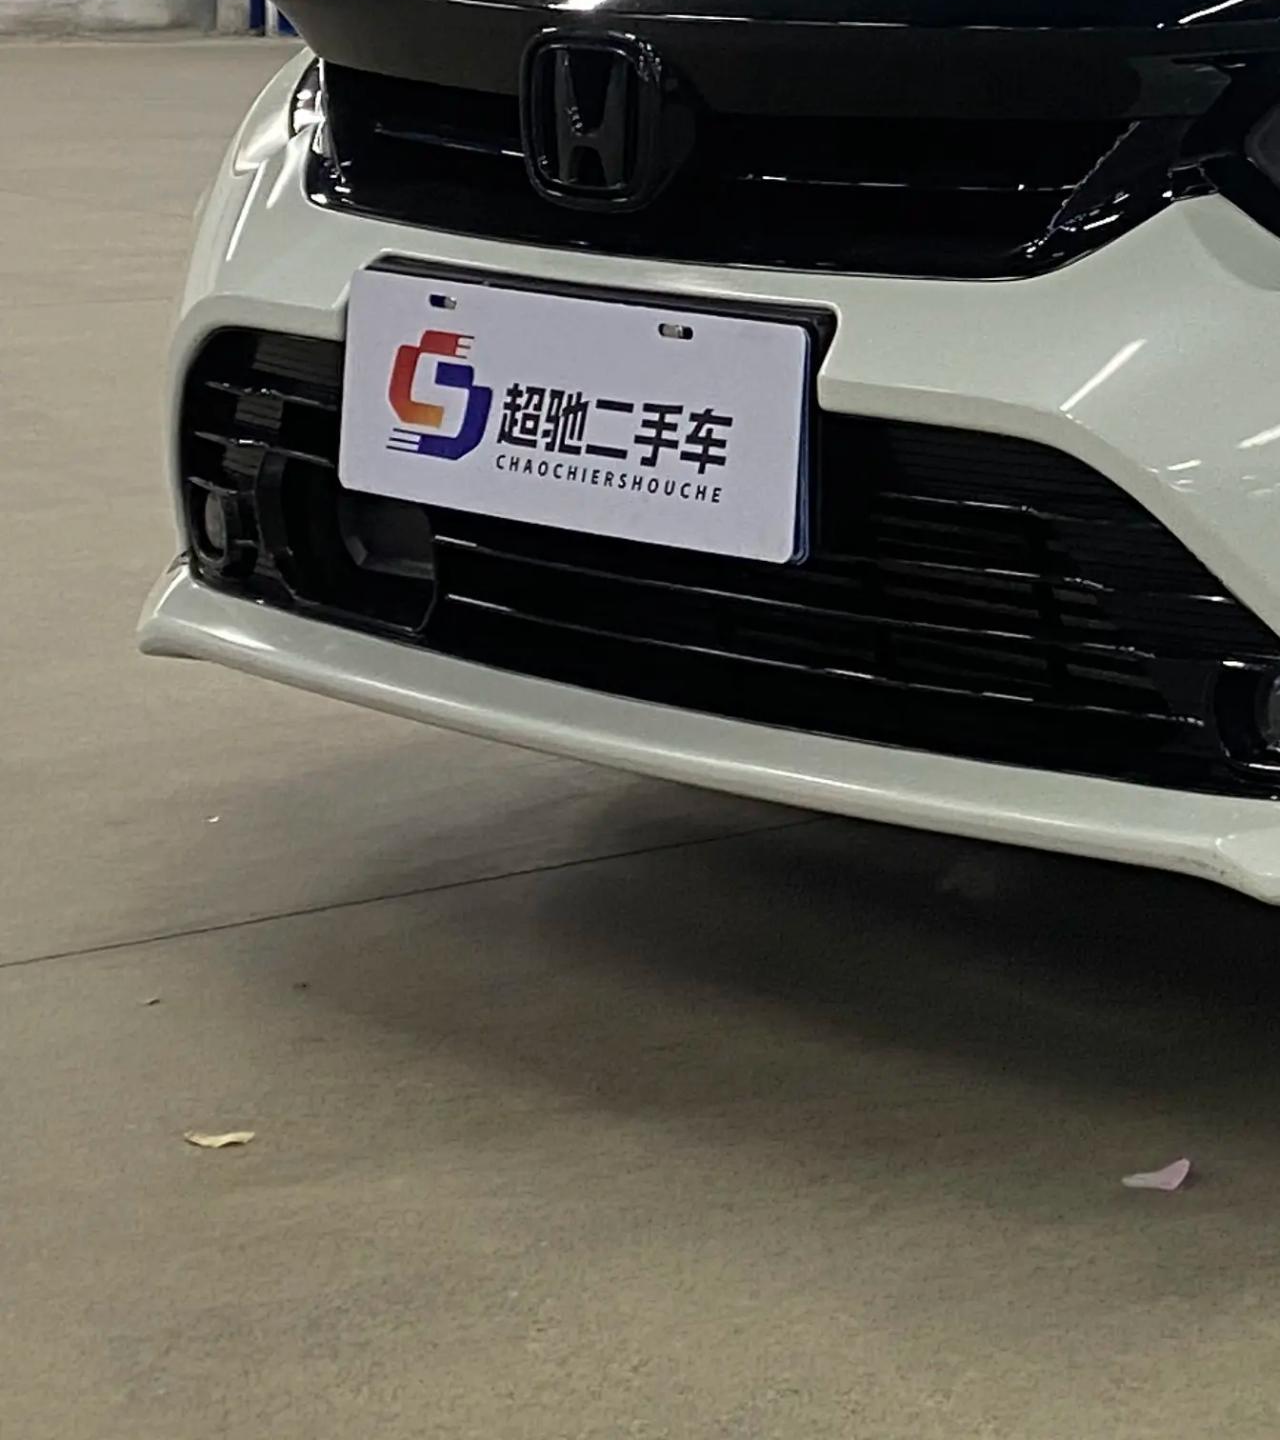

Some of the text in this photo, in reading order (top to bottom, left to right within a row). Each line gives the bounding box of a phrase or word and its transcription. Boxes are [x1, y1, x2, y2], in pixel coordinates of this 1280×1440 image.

[497, 384, 733, 474] 超驰二手车
[496, 455, 723, 503] CHAOCHIERSHOUCHE
